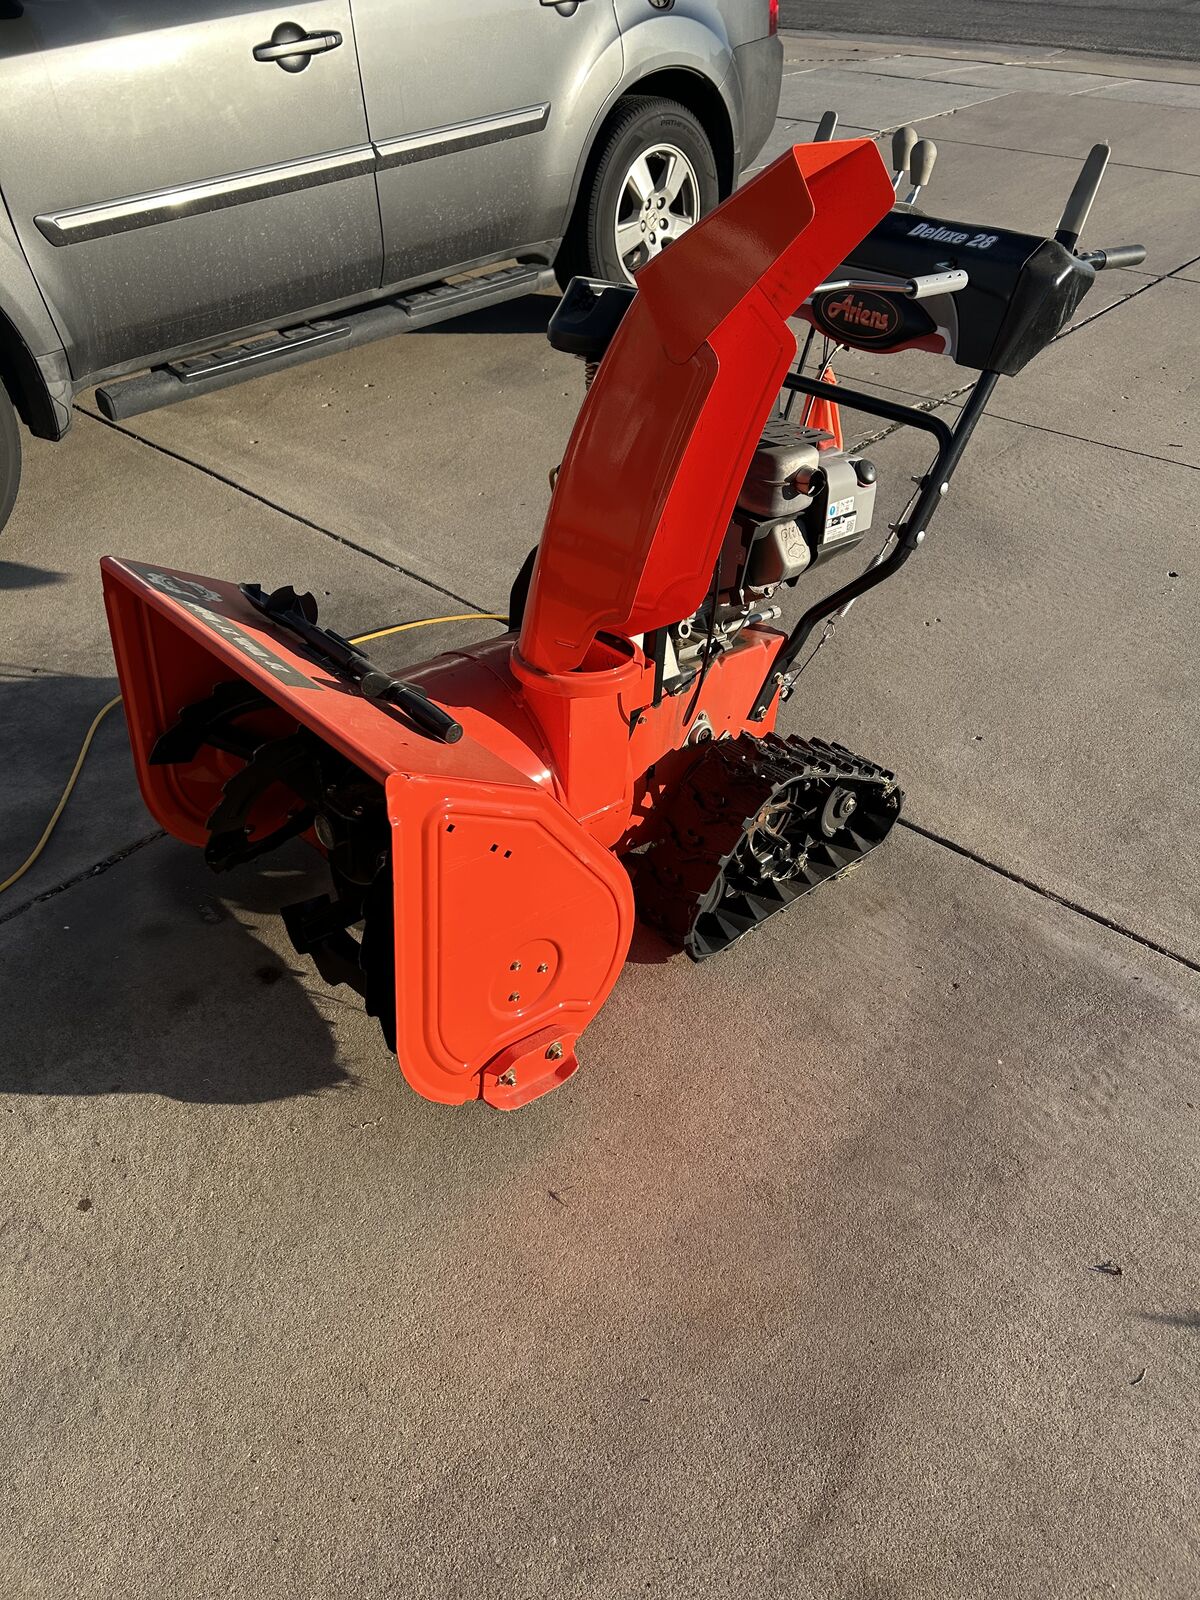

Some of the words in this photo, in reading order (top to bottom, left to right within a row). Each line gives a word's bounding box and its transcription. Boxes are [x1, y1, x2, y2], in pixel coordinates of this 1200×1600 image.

[907, 223, 967, 244] Deluxe
[966, 234, 998, 249] 28
[827, 294, 889, 331] Ariens
